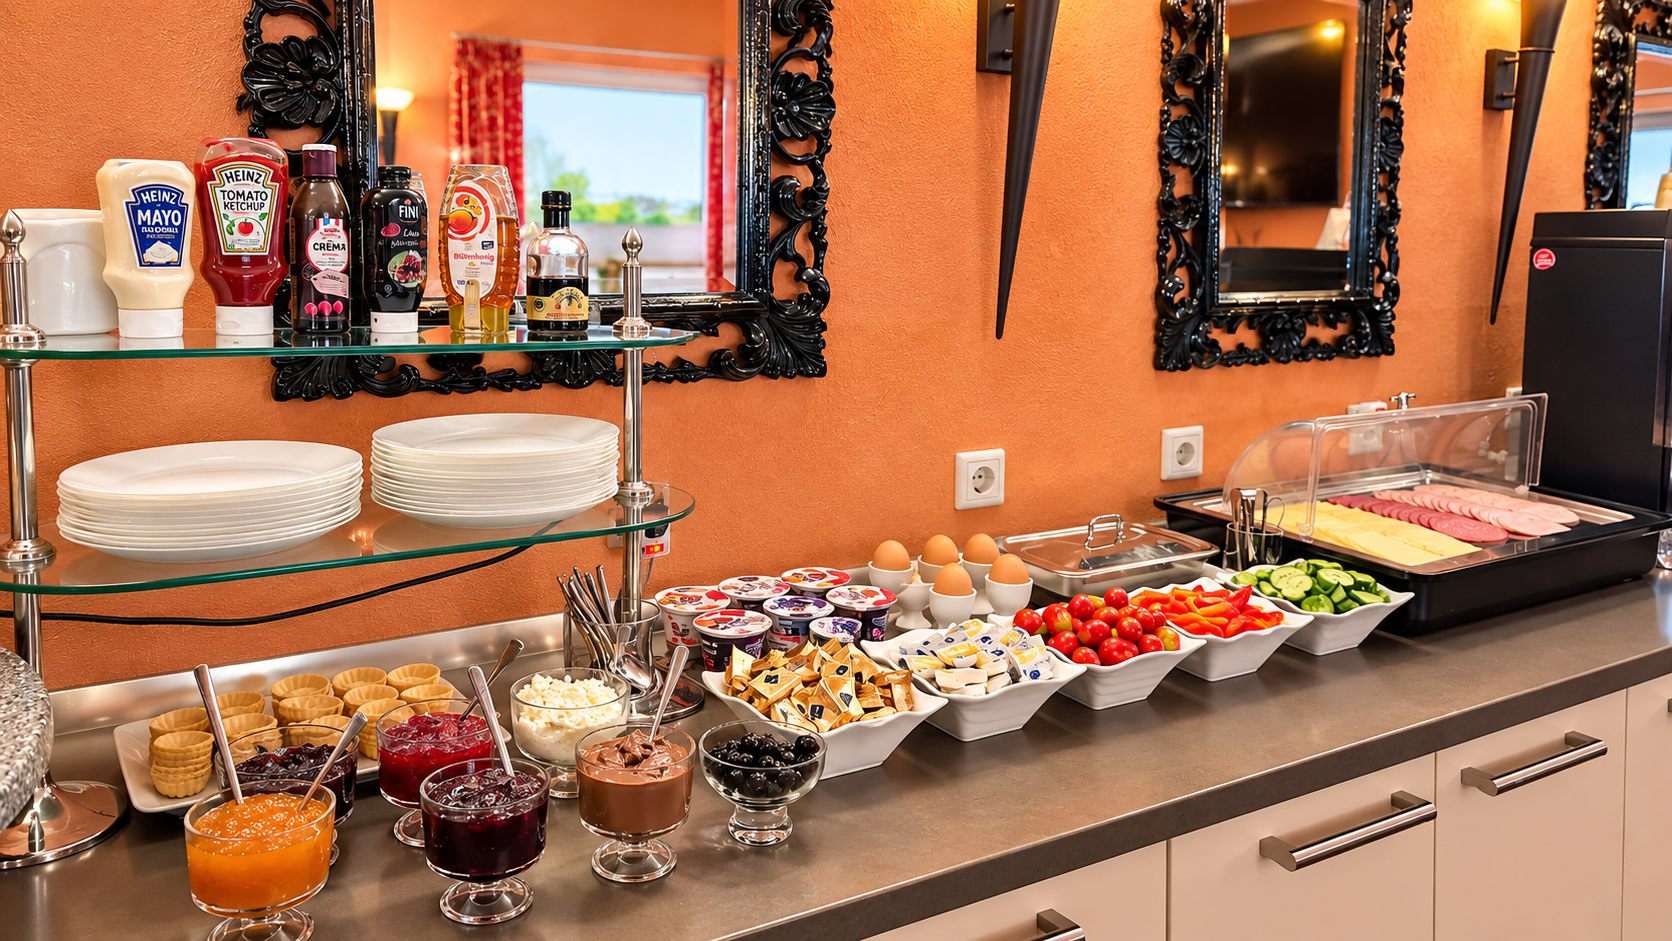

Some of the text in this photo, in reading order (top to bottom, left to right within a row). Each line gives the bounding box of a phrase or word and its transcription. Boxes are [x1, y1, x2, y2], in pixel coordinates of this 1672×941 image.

[224, 170, 263, 184] HEINZ
[140, 190, 178, 205] HEINZ
[220, 190, 268, 201] TOMATO
[223, 201, 265, 211] KETCHUP
[398, 205, 419, 219] FINI
[137, 209, 182, 226] MAYO
